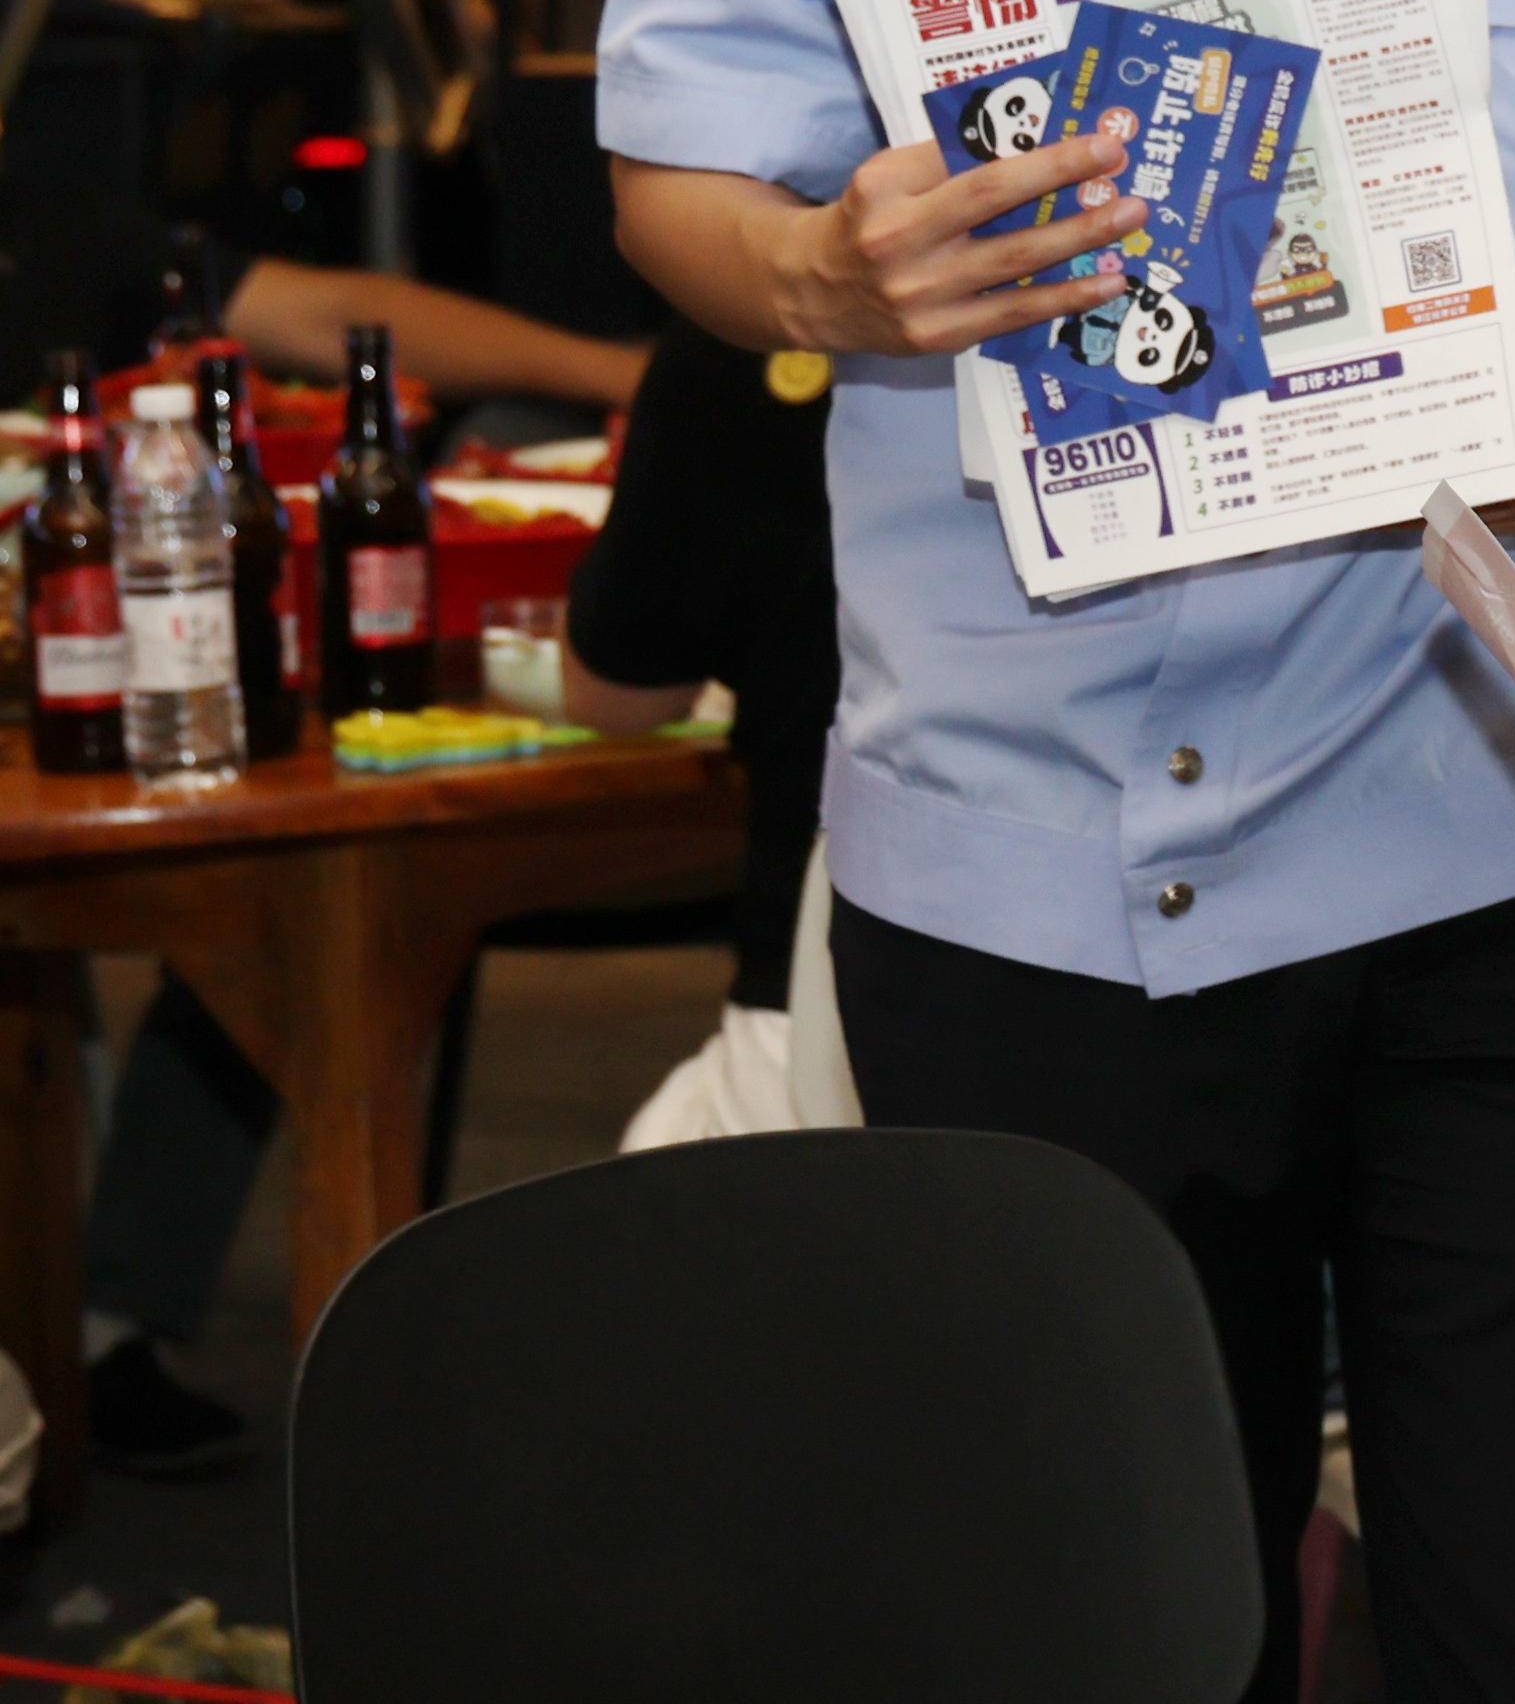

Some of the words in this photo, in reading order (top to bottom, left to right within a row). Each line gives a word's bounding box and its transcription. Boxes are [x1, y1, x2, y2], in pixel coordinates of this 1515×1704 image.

[1130, 55, 1206, 202] 防止诈骗
[1289, 359, 1382, 395] 防诈小妙招
[1184, 432, 1194, 449] 1
[1044, 431, 1137, 477] 96110
[1189, 456, 1200, 472] 2
[1193, 479, 1204, 495] 3
[1196, 502, 1208, 518] 4
